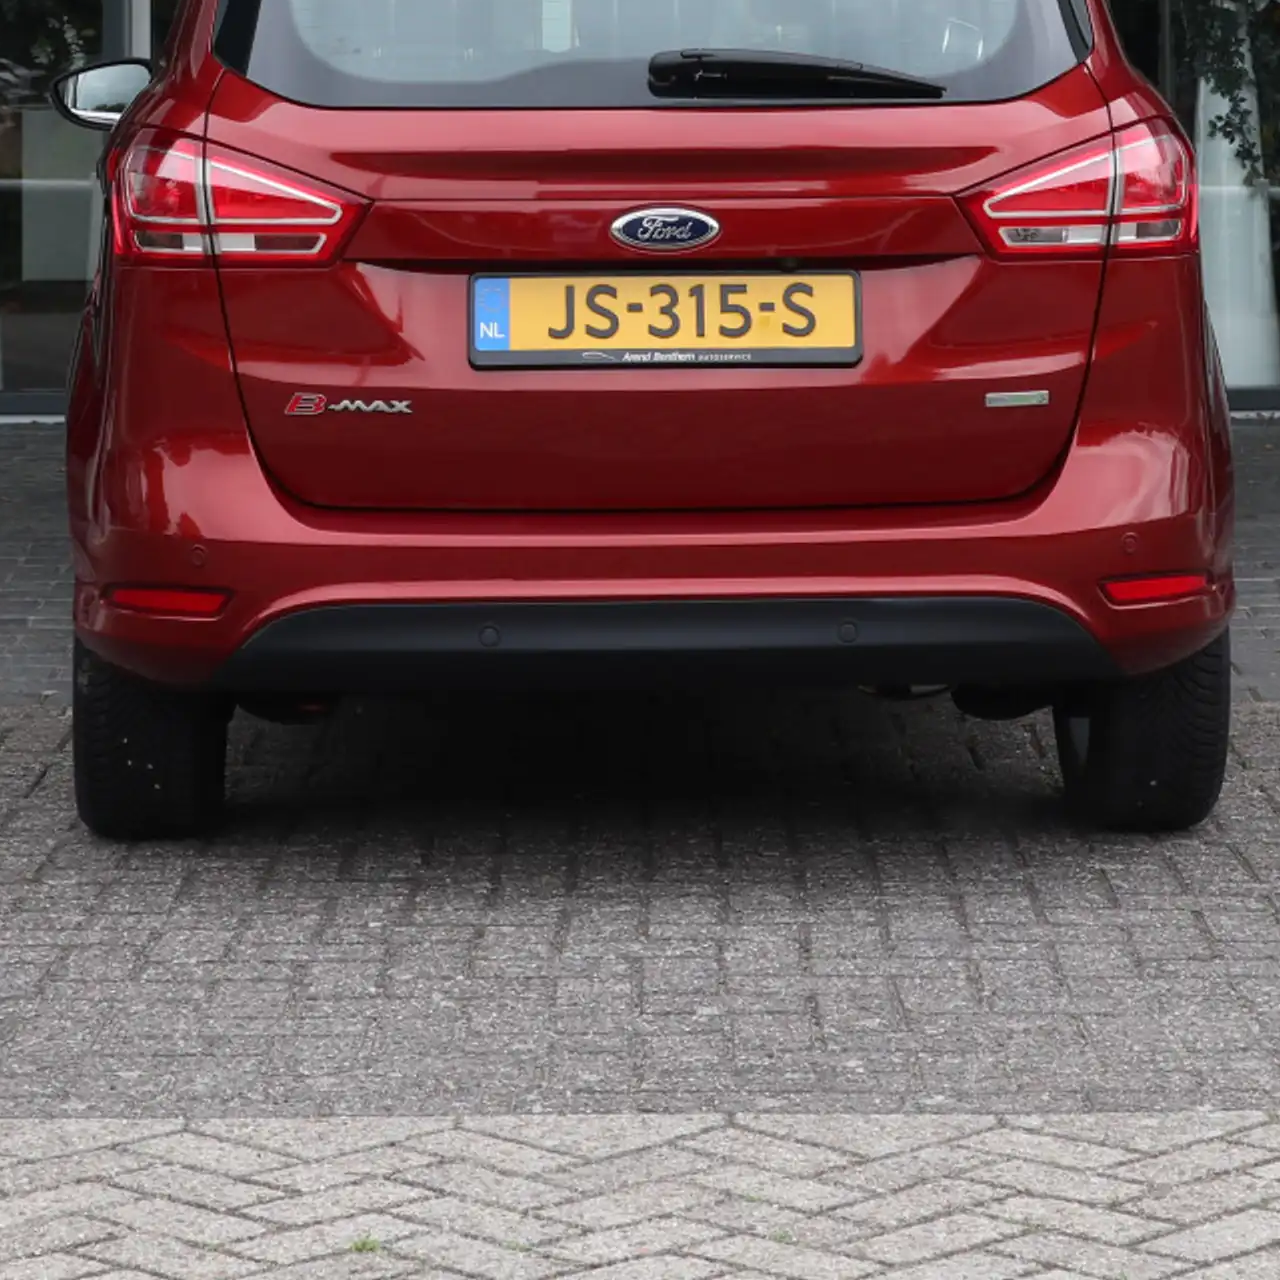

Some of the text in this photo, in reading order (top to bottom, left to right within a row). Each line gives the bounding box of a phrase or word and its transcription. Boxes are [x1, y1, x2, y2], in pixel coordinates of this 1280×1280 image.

[637, 215, 694, 240] Ford
[548, 282, 817, 340] JS-315-S
[479, 322, 505, 339] NL
[621, 351, 652, 362] Arend
[284, 391, 413, 415] B-MAX
